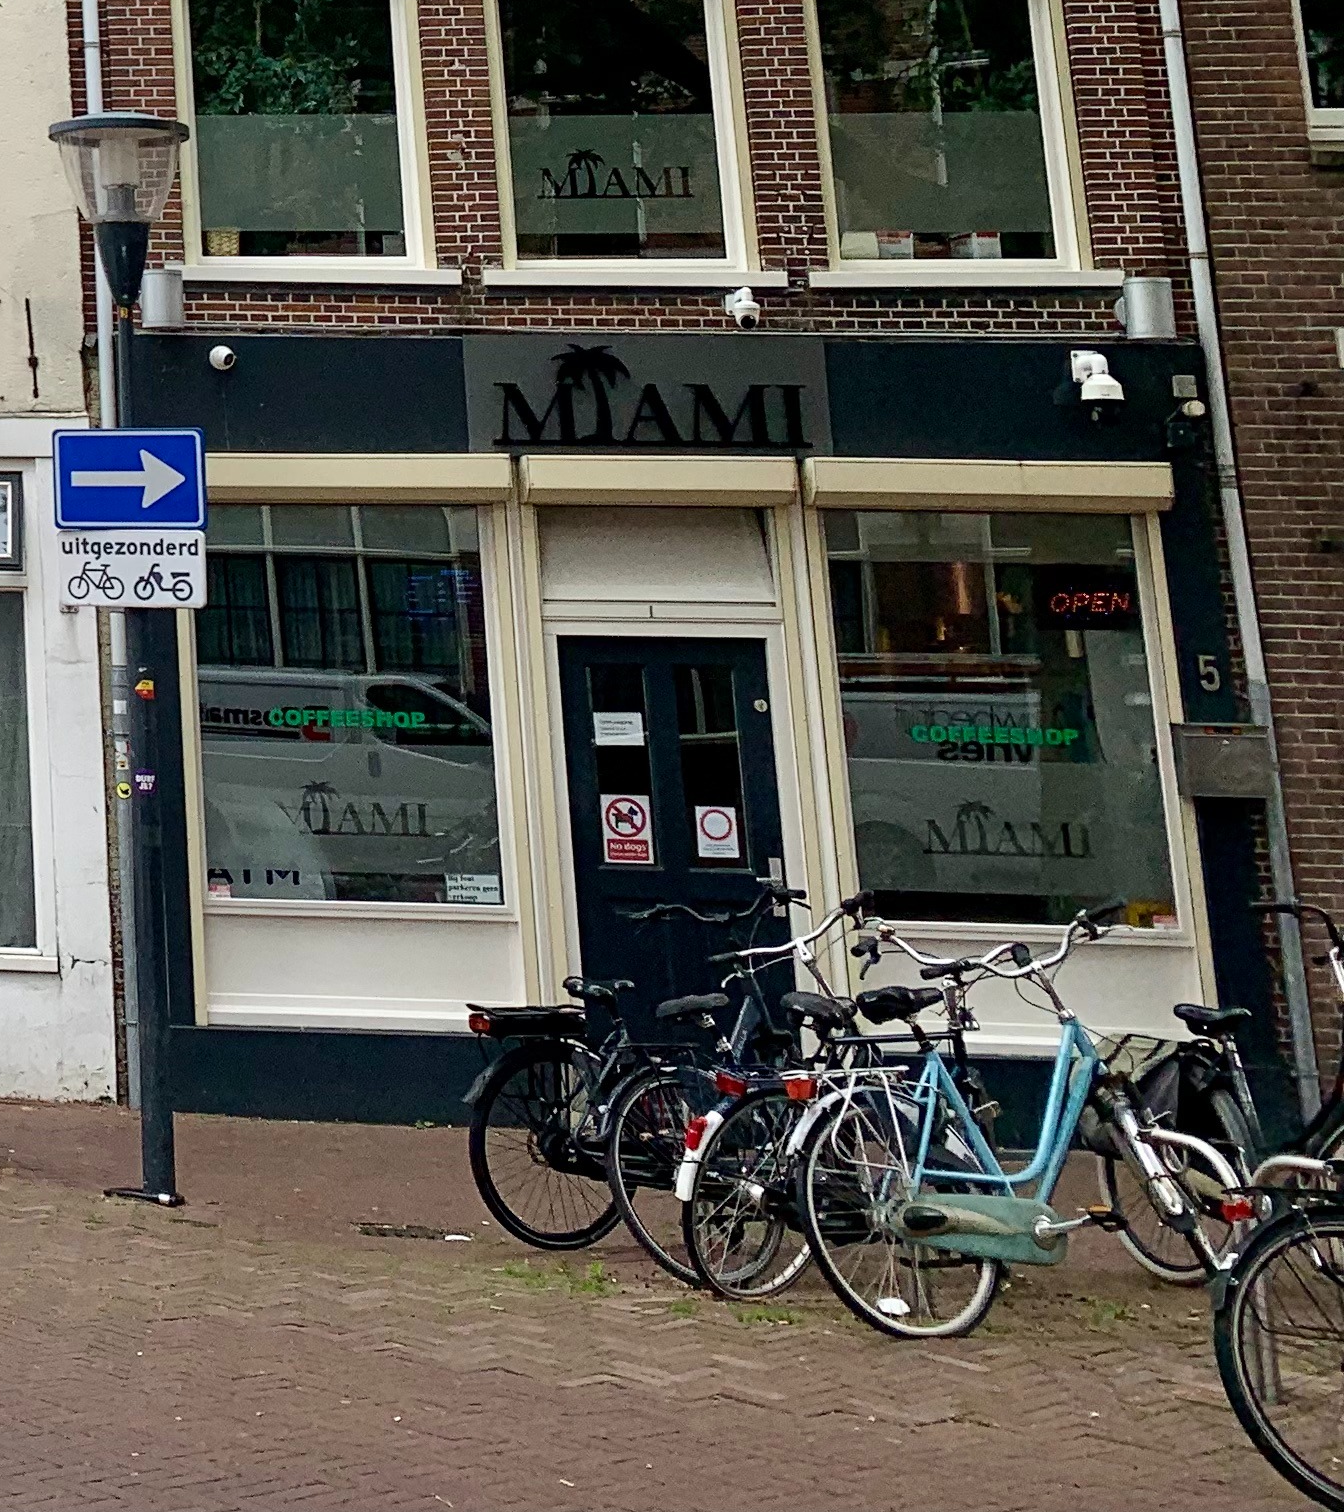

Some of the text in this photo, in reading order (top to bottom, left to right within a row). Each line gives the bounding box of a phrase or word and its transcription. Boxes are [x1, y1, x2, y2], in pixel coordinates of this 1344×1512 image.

[537, 149, 695, 198] MIAMI
[493, 345, 813, 447] MIAMI
[62, 538, 199, 560] uitgezonderd
[1049, 592, 1130, 613] OPEN
[1197, 654, 1220, 691] 5
[268, 707, 426, 728] COFFEESHOP
[911, 724, 1079, 745] COFFEESHOP
[274, 780, 431, 837] MIAMI
[923, 800, 1095, 859] MIAMI
